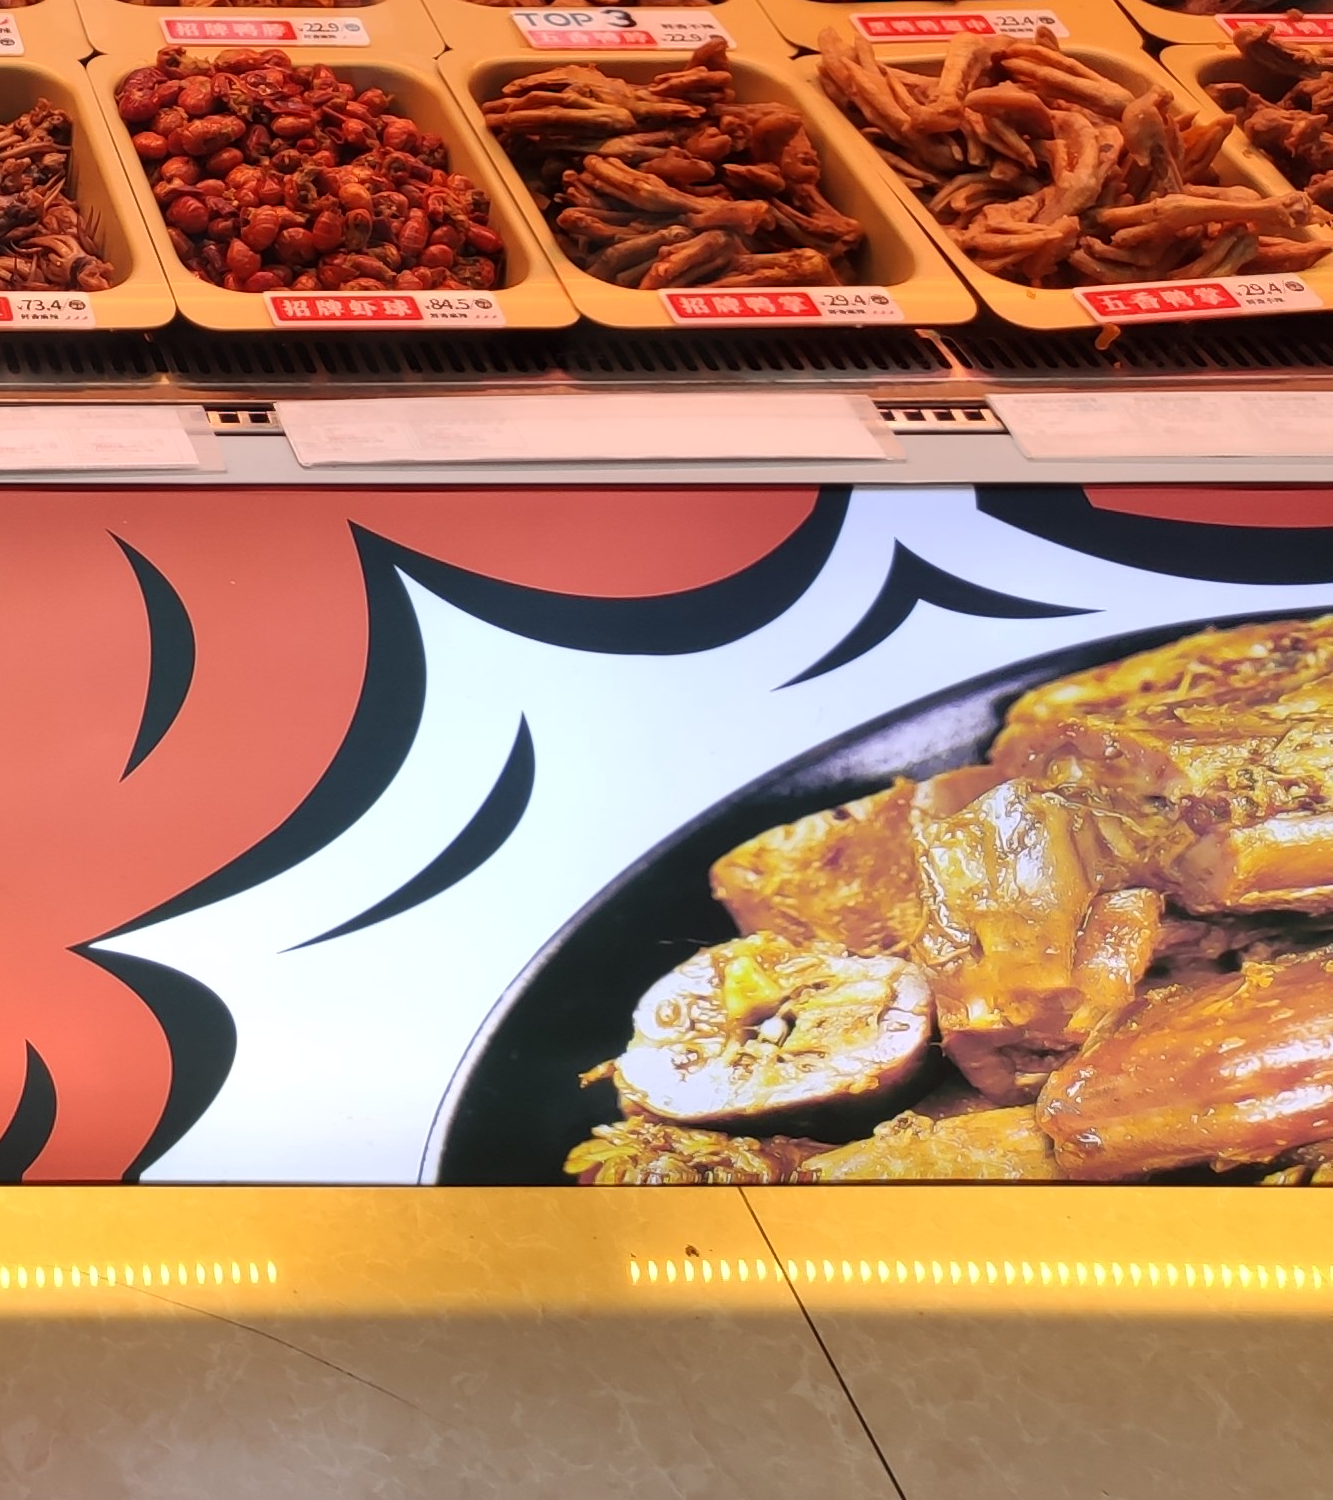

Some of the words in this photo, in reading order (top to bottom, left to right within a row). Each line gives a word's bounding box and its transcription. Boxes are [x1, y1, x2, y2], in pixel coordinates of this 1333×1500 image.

[514, 12, 593, 27] TOP
[601, 9, 637, 28] 3
[282, 298, 413, 317] 招牌虾球
[679, 296, 811, 315] 招牌鸭掌
[1099, 287, 1226, 312] 五香鸭掌
